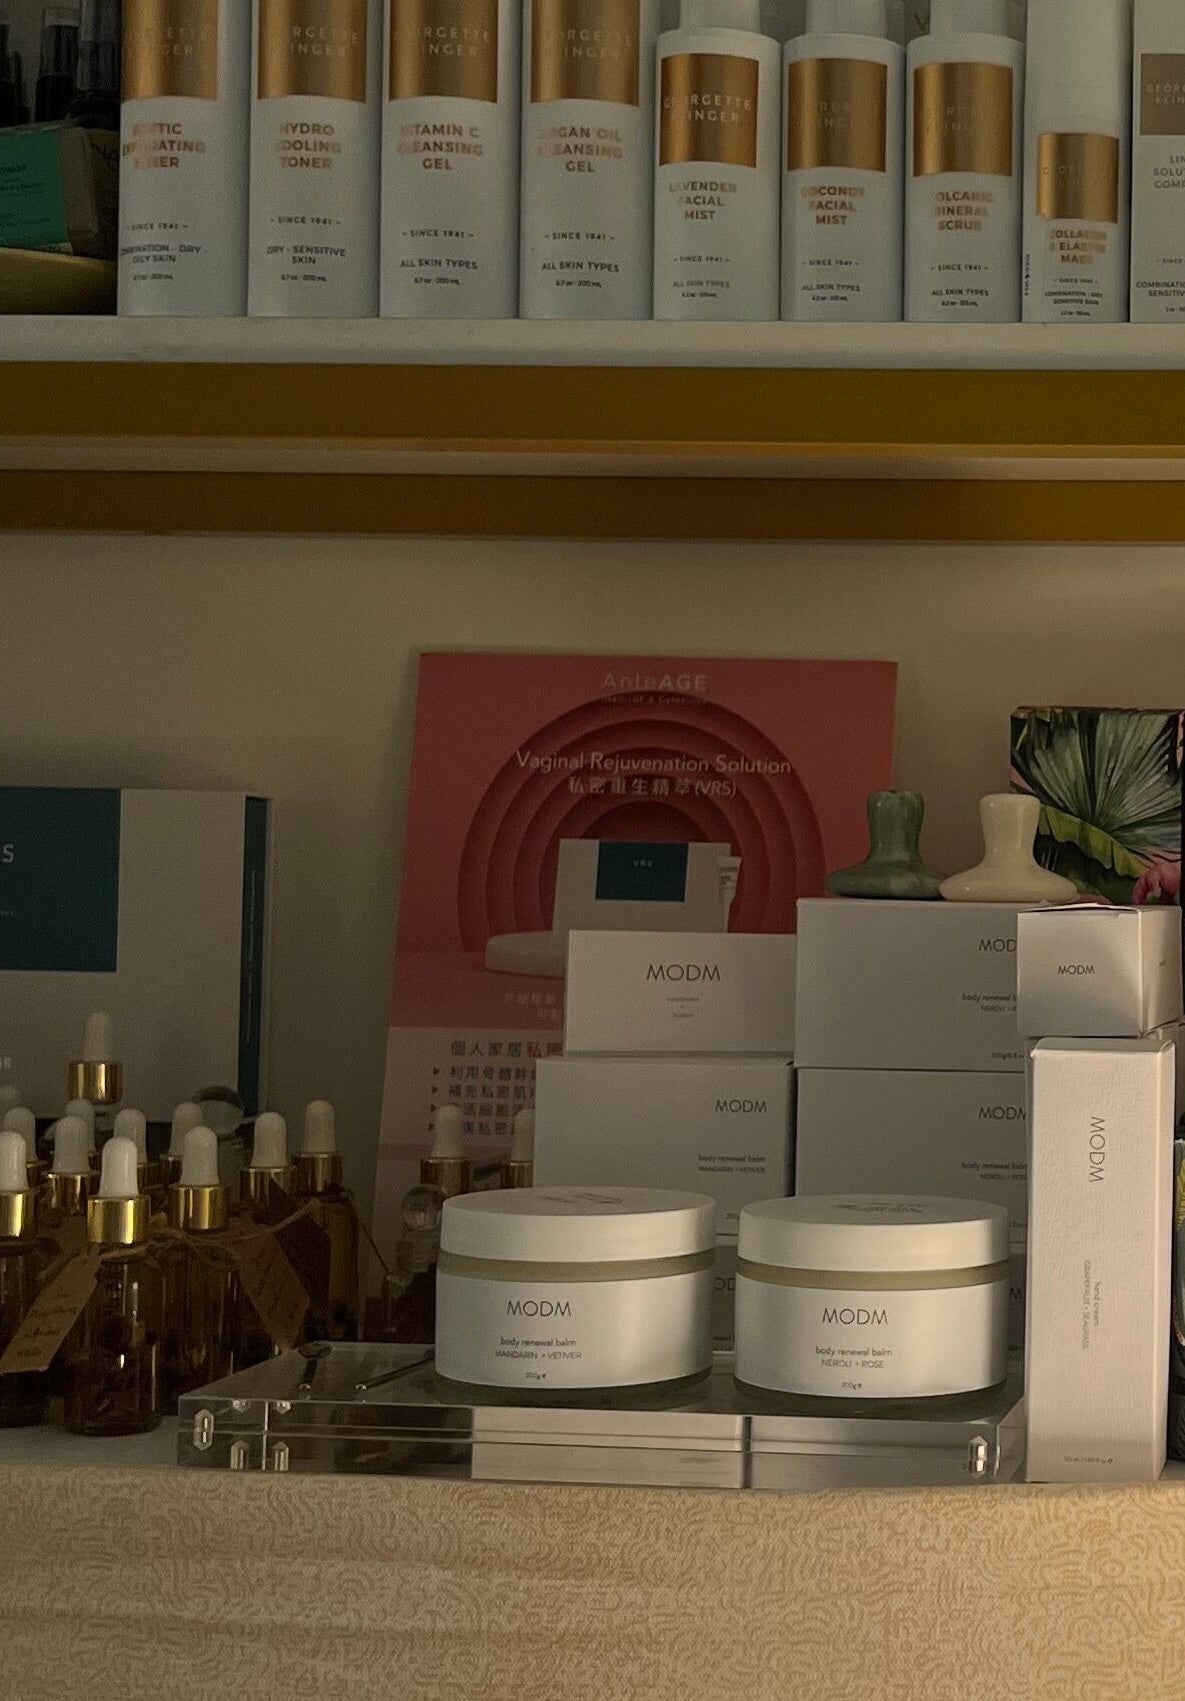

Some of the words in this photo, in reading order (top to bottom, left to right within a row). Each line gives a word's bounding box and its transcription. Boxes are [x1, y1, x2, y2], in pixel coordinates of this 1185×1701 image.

[279, 123, 336, 136] HYDRO
[280, 157, 333, 170] TONER
[421, 157, 454, 171] GEL
[565, 160, 597, 173] GEL
[684, 210, 717, 221] MIST
[815, 215, 848, 225] MIST
[410, 229, 439, 238] SINCE
[443, 229, 465, 239] 1941
[552, 231, 581, 240] SINCE
[585, 232, 607, 241] 1941
[292, 245, 347, 258] SENSITIVE
[291, 256, 317, 265] SKIN
[400, 259, 416, 268] ALL
[418, 258, 442, 268] SKIN
[445, 259, 479, 271] TYPES
[541, 261, 557, 271] ALL
[559, 261, 583, 271] SKIN
[587, 262, 620, 273] TYPES
[516, 750, 584, 774] Vaginal
[590, 750, 709, 775] Rejuvenation
[715, 754, 792, 775] Solution
[978, 938, 1016, 952] MOD
[647, 963, 721, 982] MODM
[1057, 964, 1095, 976] MODM
[715, 1099, 768, 1113] MODM
[1087, 1115, 1105, 1184] MODM
[507, 1300, 572, 1317] MODM
[822, 1308, 889, 1325] MODM
[500, 1336, 519, 1348] body
[521, 1337, 553, 1347] renewal
[555, 1336, 577, 1347] balm
[495, 1351, 538, 1359] MANDARIN
[546, 1351, 582, 1360] VETIVER
[815, 1345, 835, 1357] body
[838, 1346, 870, 1356] renewal
[872, 1345, 893, 1356] balm
[820, 1359, 853, 1369] NEROLI
[861, 1359, 885, 1369] ROSE
